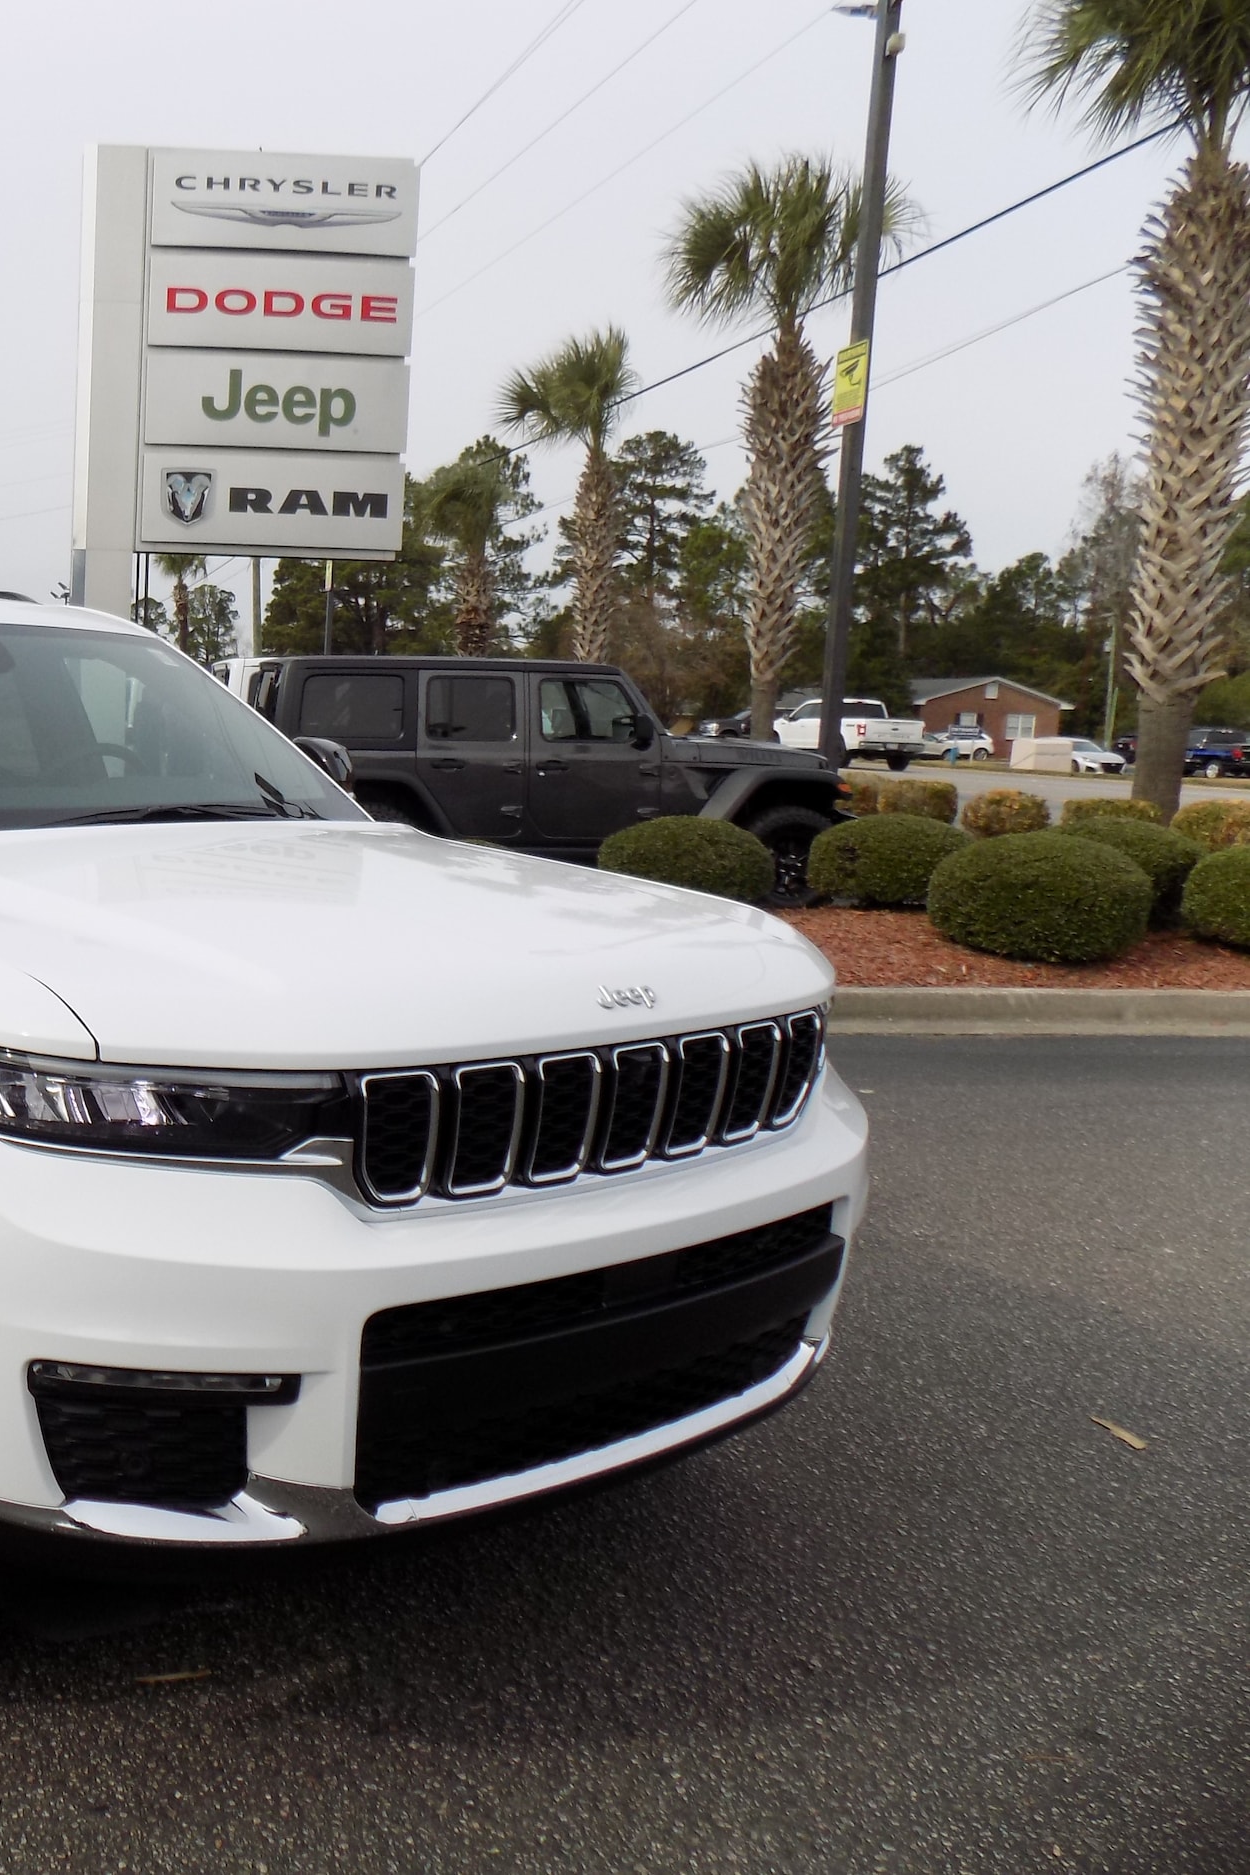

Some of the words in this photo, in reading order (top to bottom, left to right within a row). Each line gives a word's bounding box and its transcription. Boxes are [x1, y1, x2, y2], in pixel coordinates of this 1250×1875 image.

[175, 175, 397, 199] CHRYSLER
[166, 287, 398, 323] DODGE
[201, 368, 357, 438] Jeep
[228, 486, 389, 519] RAM
[596, 984, 656, 1009] Jeep
